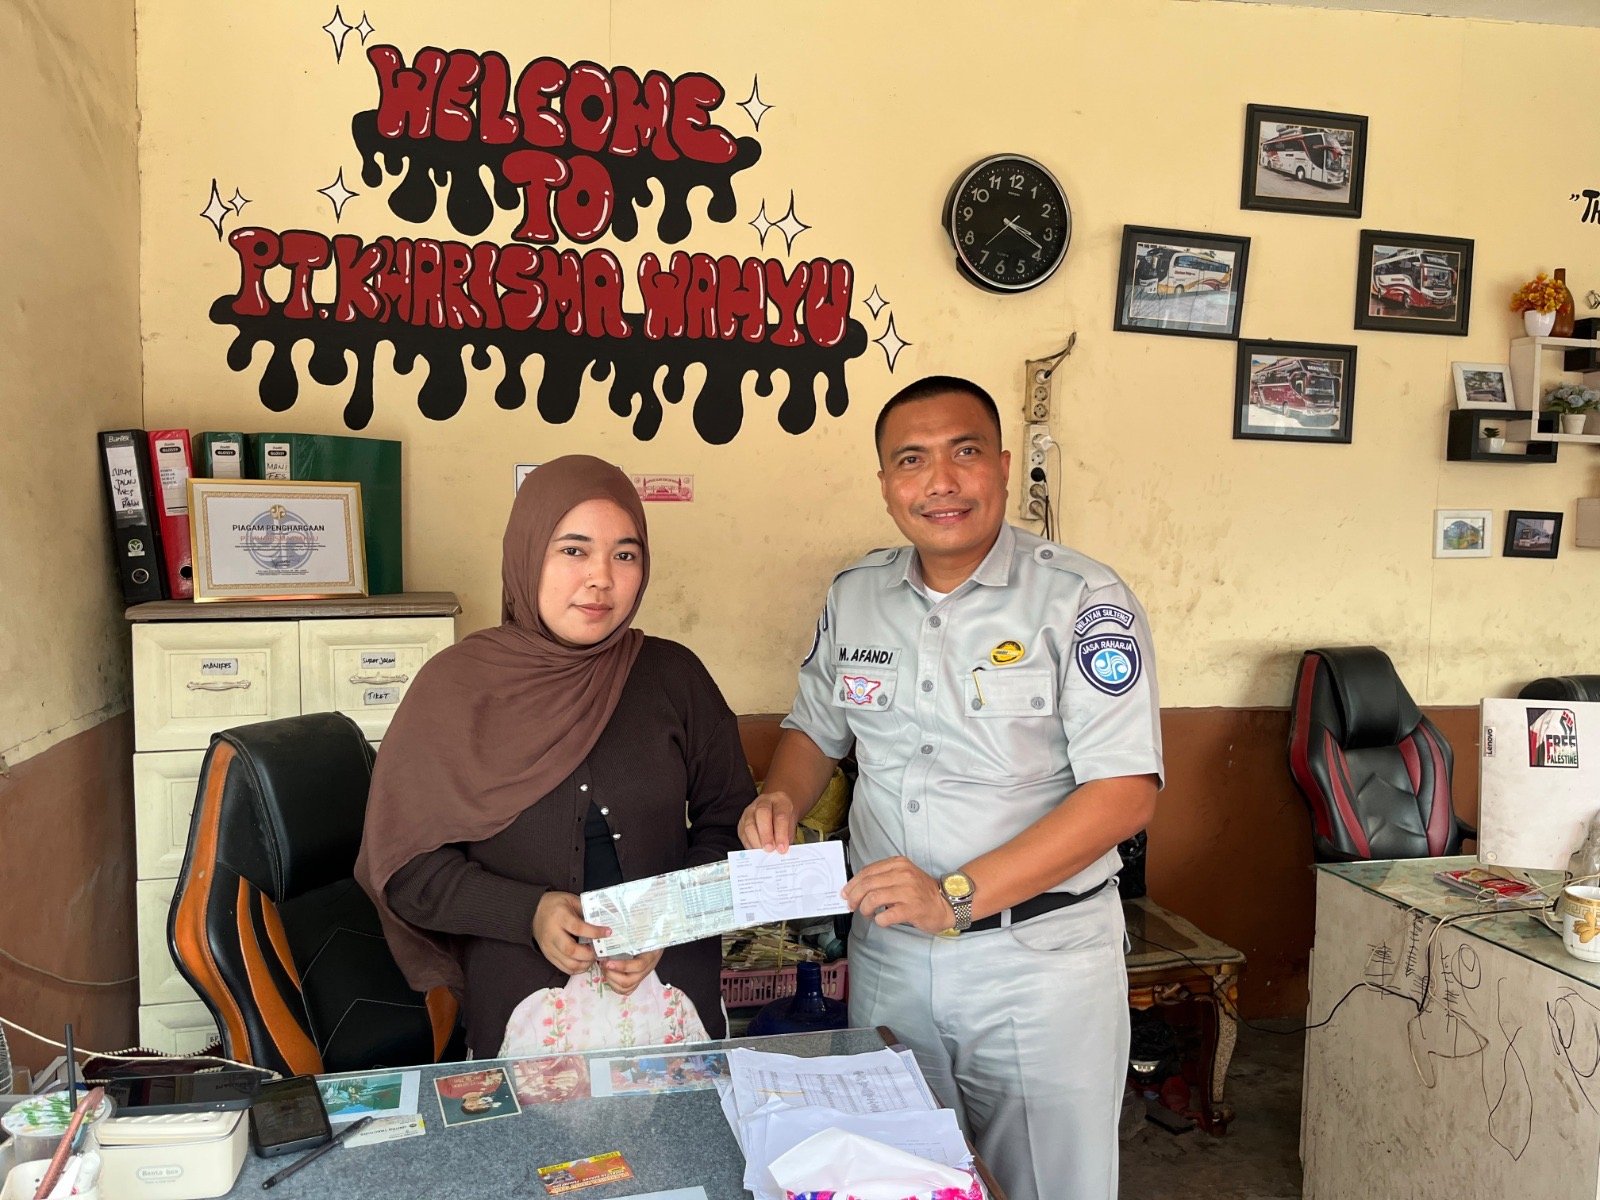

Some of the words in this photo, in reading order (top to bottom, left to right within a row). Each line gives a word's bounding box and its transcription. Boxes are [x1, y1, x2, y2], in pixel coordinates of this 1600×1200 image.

[989, 174, 1002, 190] 11
[1009, 174, 1025, 190] 12
[503, 150, 614, 243] TO
[971, 187, 990, 203] 10
[1031, 186, 1038, 200] 1
[964, 207, 973, 221] 9
[1041, 203, 1052, 219] 2
[965, 231, 974, 244] 8
[1043, 228, 1052, 241] 3
[980, 250, 989, 264] 7
[995, 260, 1005, 274] 6
[1016, 260, 1025, 273] 5
[637, 250, 855, 348] WAHYU
[232, 524, 265, 532] PIAGAM
[266, 524, 325, 532] PENGHARGAAN
[1075, 608, 1102, 631] WILAYAH
[1102, 609, 1129, 623] SULTENG
[1082, 642, 1100, 655] JASA
[1100, 640, 1132, 652] RAHARJA
[839, 647, 849, 662] M.
[850, 648, 894, 665] AFANDI
[1545, 734, 1576, 755] FREE
[1546, 754, 1577, 764] PALESTINE
